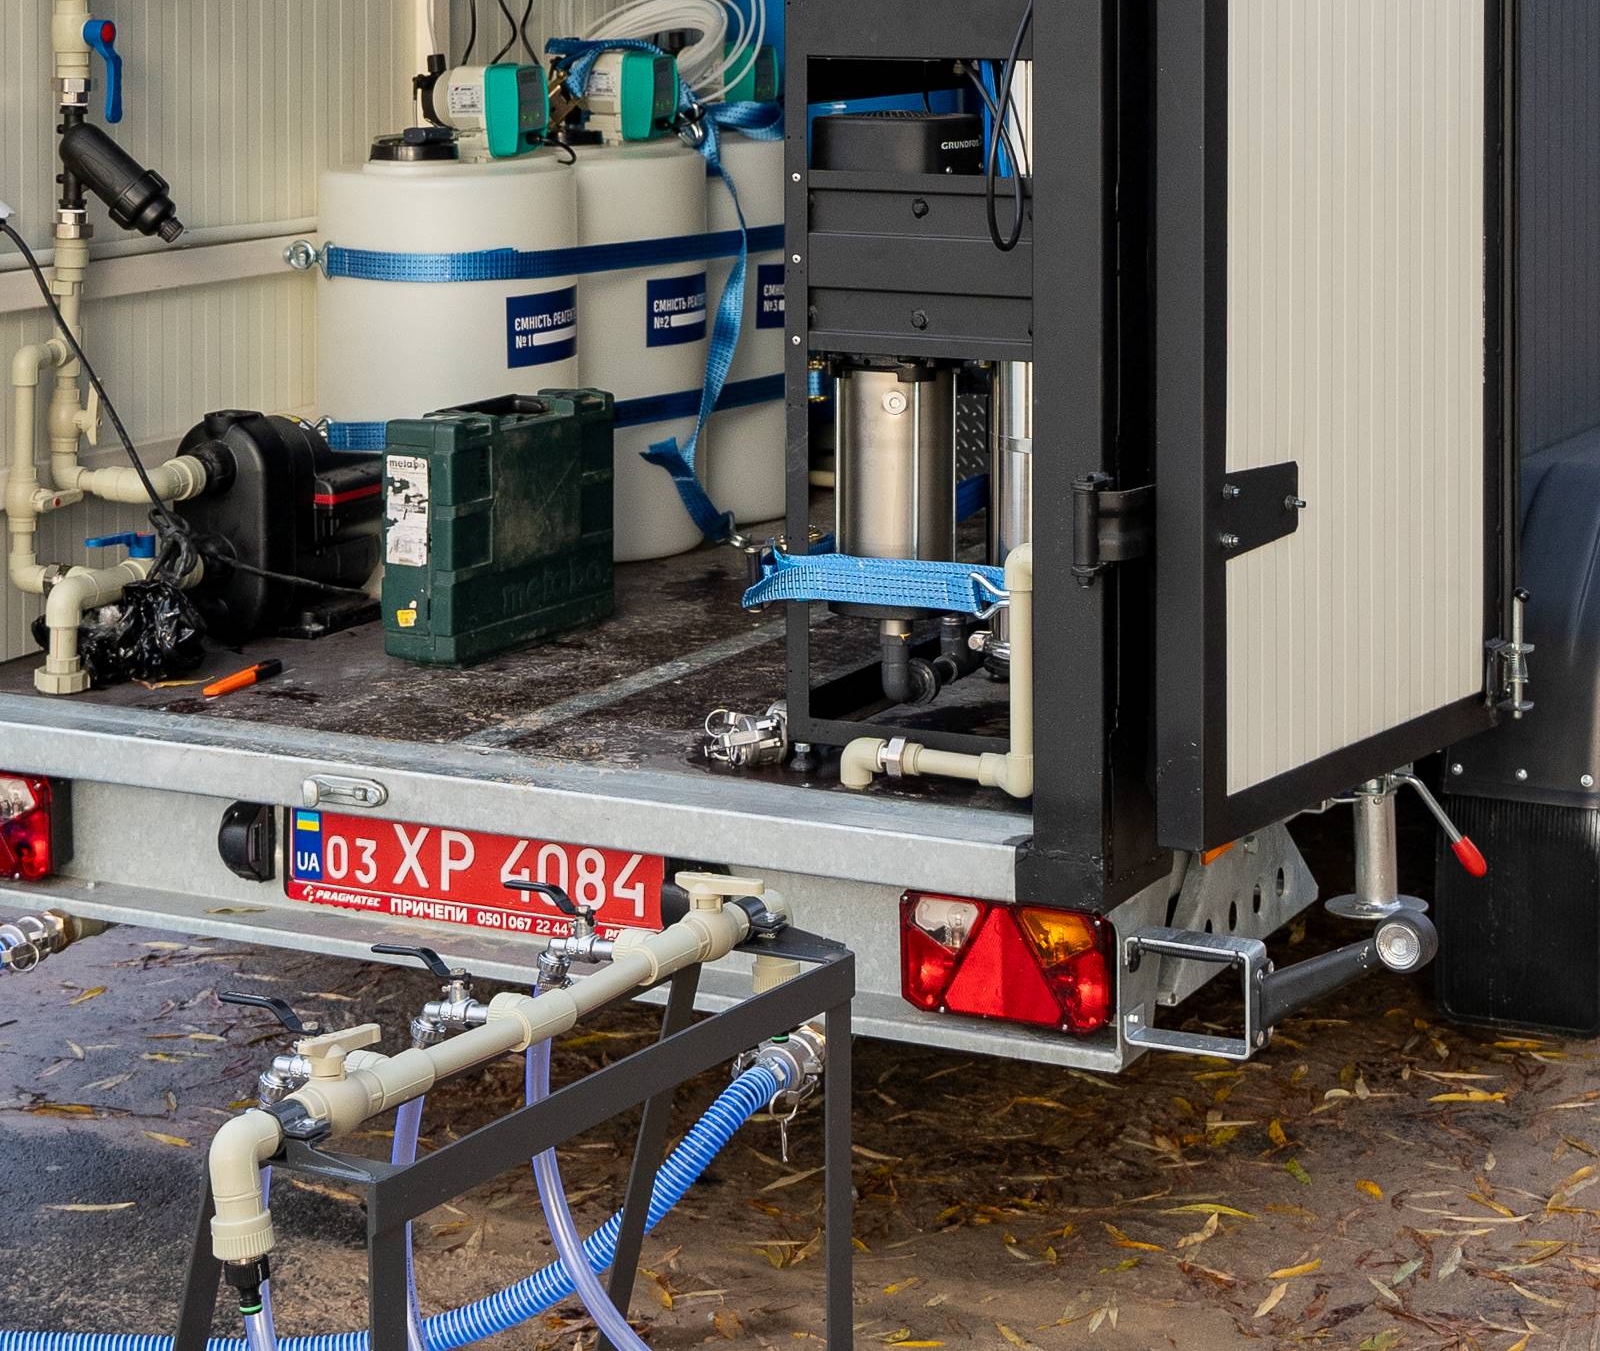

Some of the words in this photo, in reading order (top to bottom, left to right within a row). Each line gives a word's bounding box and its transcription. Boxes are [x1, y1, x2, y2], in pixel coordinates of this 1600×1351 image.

[653, 297, 686, 313] ЄМНІСТЬ
[514, 314, 552, 331] ЄМНІСТЬ
[653, 315, 670, 329] №2
[515, 334, 532, 349] №1
[389, 459, 426, 470] metabo
[297, 851, 320, 872] UA
[326, 835, 378, 884] 03
[392, 823, 475, 891] XP
[500, 840, 645, 918] 4084
[315, 889, 381, 907] PRAGMATEC
[390, 898, 467, 922] ПРИЧЕПИ
[536, 919, 550, 934] 22
[552, 921, 568, 936] 44
